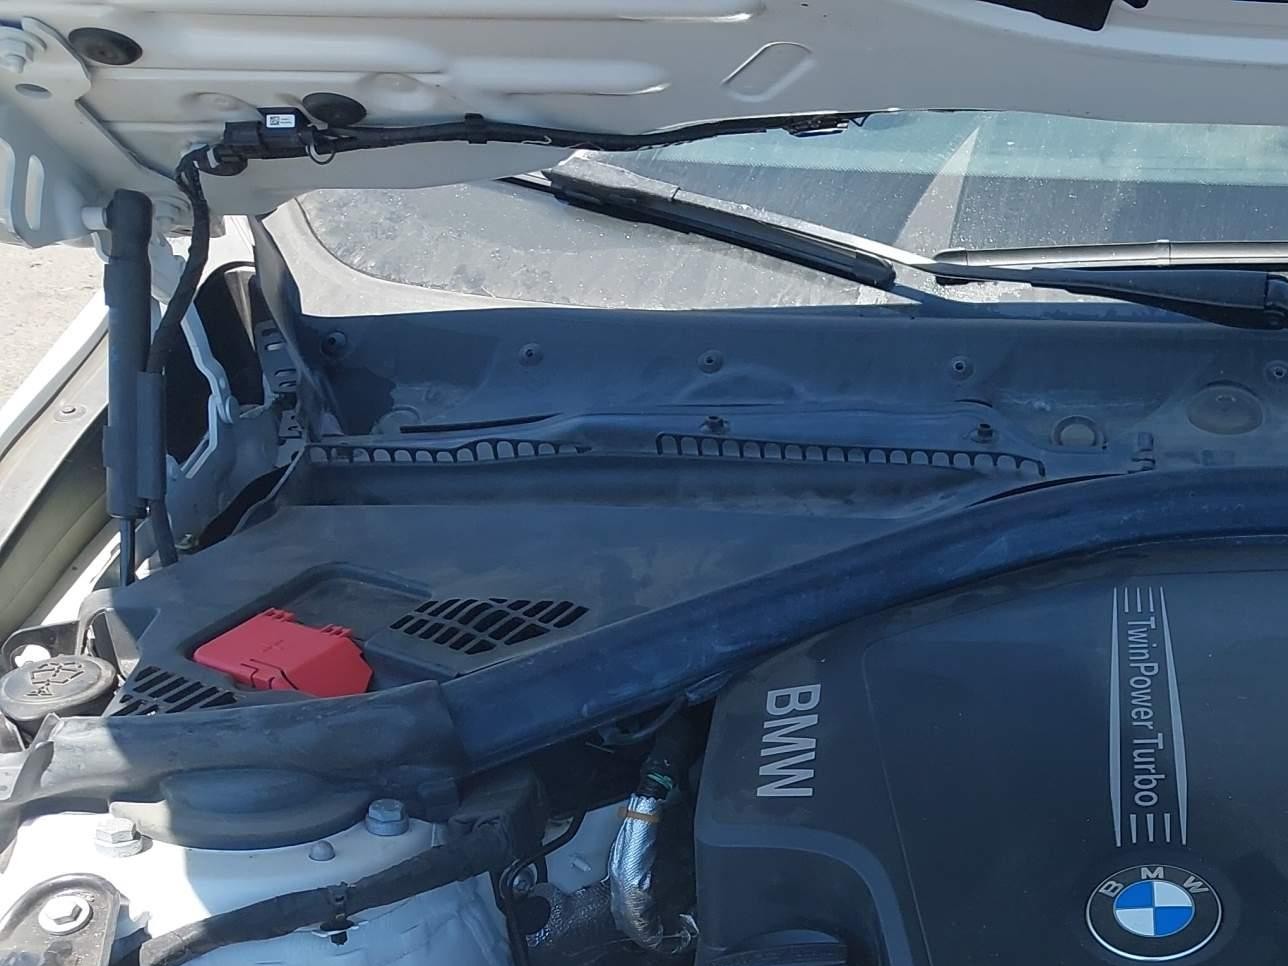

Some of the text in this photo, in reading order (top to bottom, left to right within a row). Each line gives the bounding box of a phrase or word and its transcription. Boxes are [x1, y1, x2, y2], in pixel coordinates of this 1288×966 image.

[756, 684, 821, 797] BMW
[1127, 616, 1166, 807] TwinPower Turbo
[1099, 866, 1209, 898] BMW
